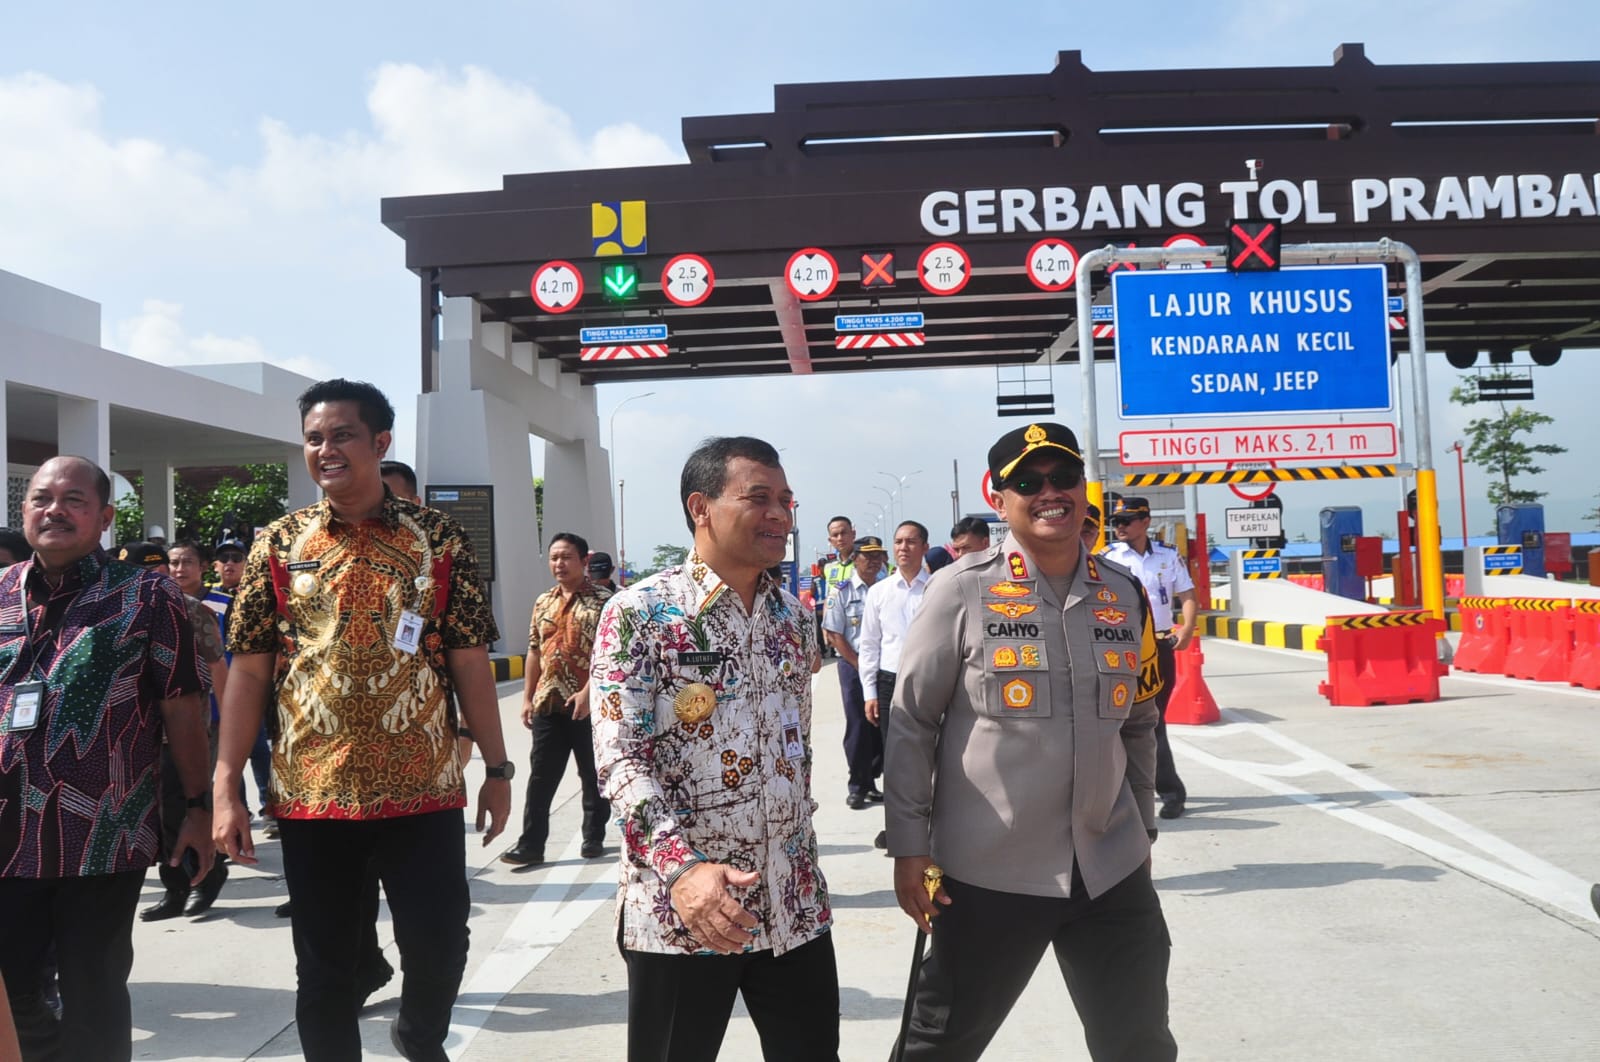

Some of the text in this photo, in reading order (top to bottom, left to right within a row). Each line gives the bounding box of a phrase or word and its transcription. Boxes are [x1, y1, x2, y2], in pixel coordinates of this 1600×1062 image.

[920, 173, 1600, 236] GERBANG TOL PRAMBA
[935, 257, 954, 269] 2.5
[1035, 259, 1070, 272] 4.2 m
[678, 267, 697, 279] 2.5
[794, 268, 828, 281] 4.2 m
[939, 272, 951, 283] m
[540, 280, 573, 294] 4.2 m
[682, 282, 694, 293] m
[1149, 289, 1352, 317] LAJUR KHUSUS
[1151, 331, 1354, 356] KENDARAAN KECIL
[1191, 371, 1319, 395] SEDAN, JEEP
[1149, 432, 1367, 456] TINGGI MAKS. 2,1 m
[1229, 513, 1278, 522] TEMPELKAN
[1241, 524, 1268, 532] KARTU
[987, 623, 1039, 638] CAHYO
[1094, 627, 1135, 642] POLRI
